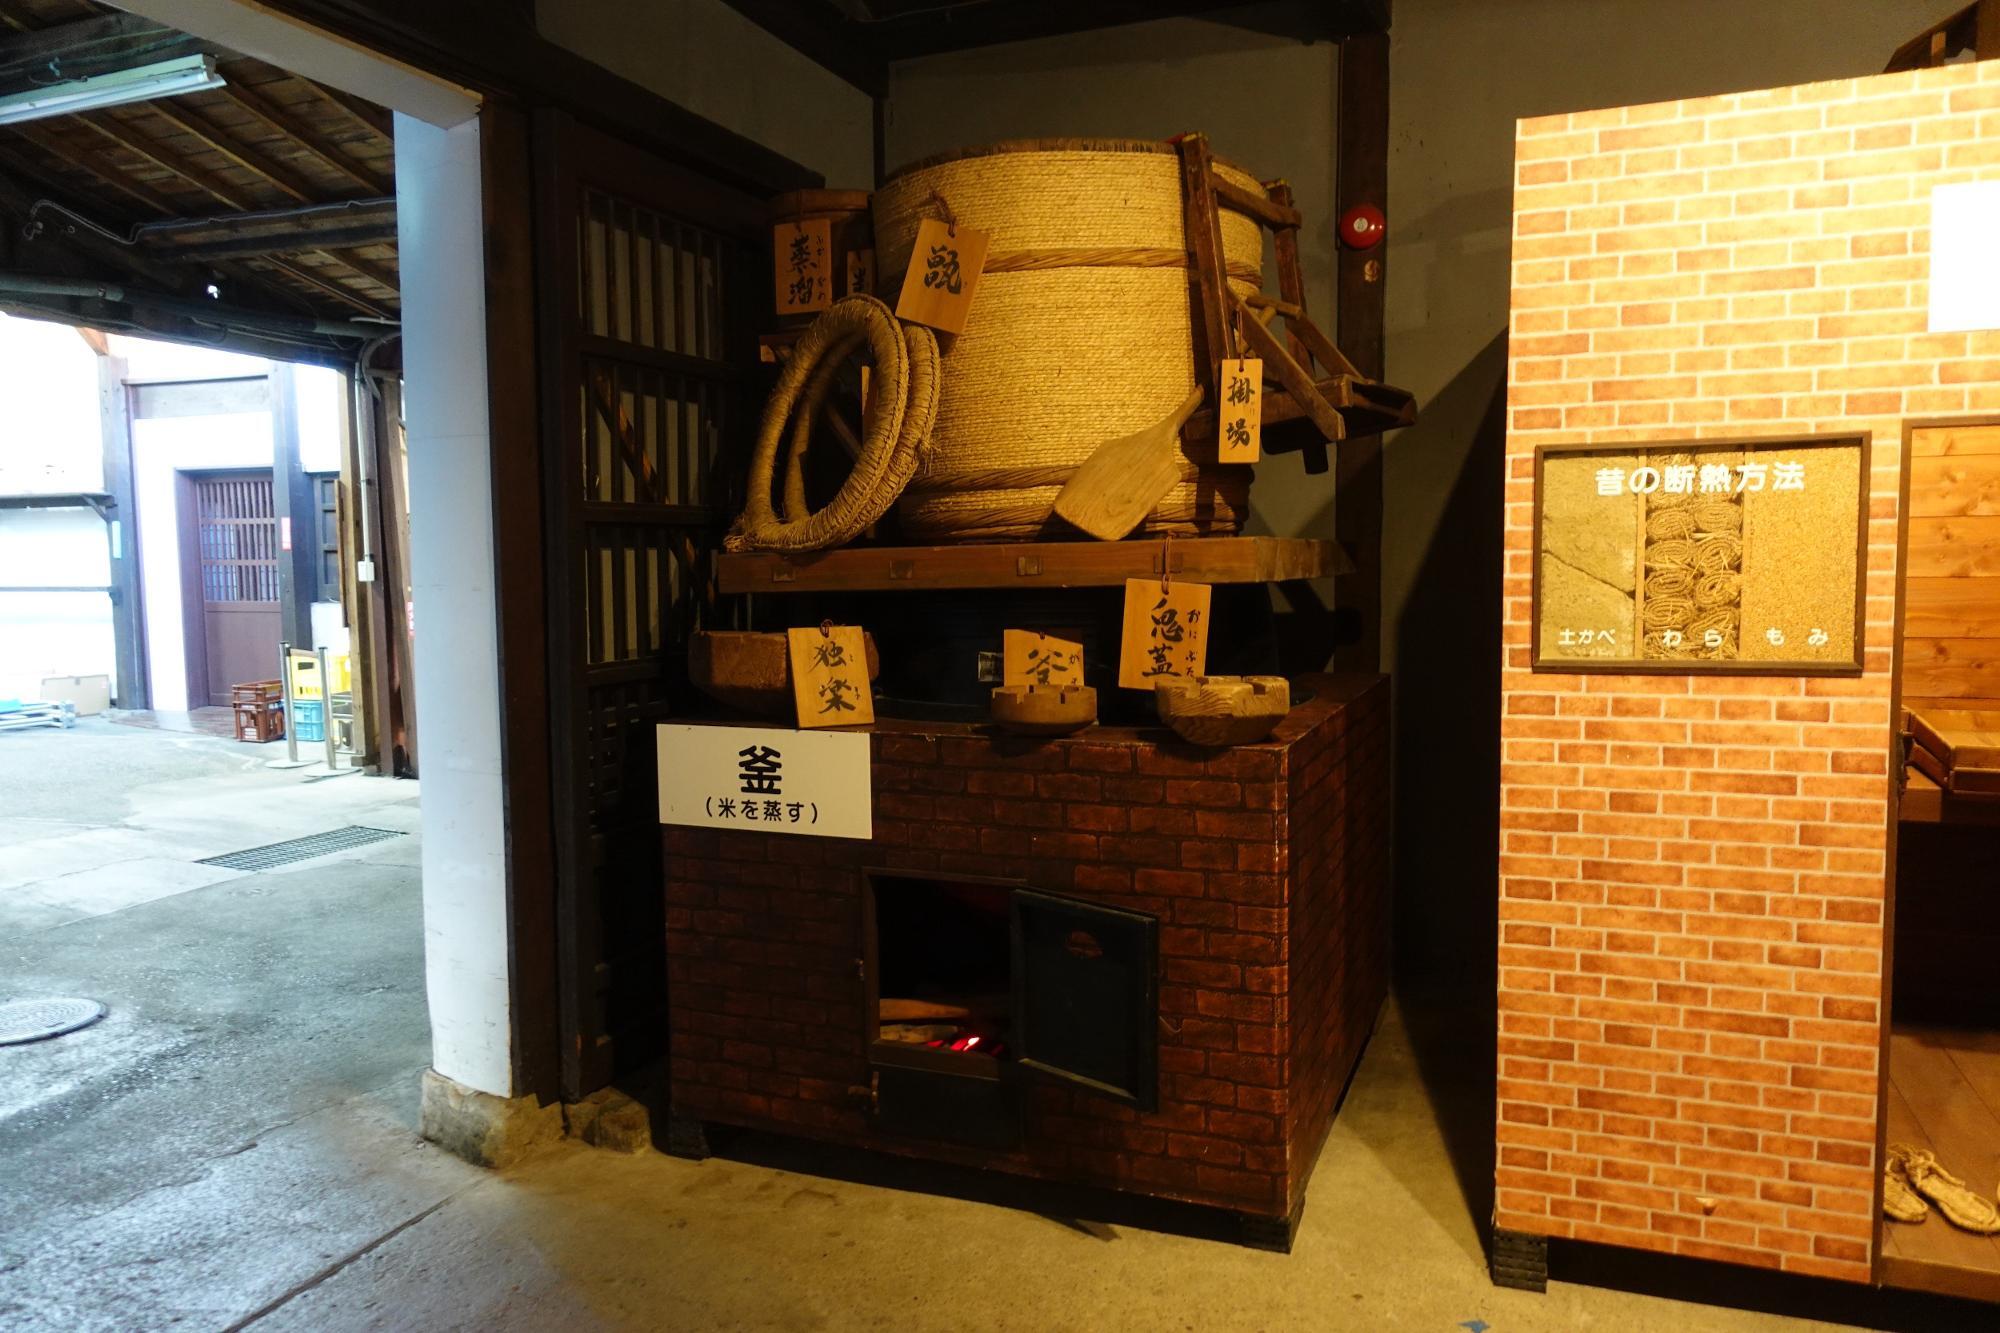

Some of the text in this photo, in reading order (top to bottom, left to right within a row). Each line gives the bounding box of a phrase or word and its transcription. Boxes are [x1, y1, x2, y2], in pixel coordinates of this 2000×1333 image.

[1594, 461, 1806, 496] 昔の断熱方法
[1142, 596, 1185, 677] 鬼蓋
[1557, 627, 1616, 646] 土かべ
[808, 641, 857, 714] 独楽
[738, 745, 783, 795] 釜
[705, 796, 819, 825] （米を蒸す）
